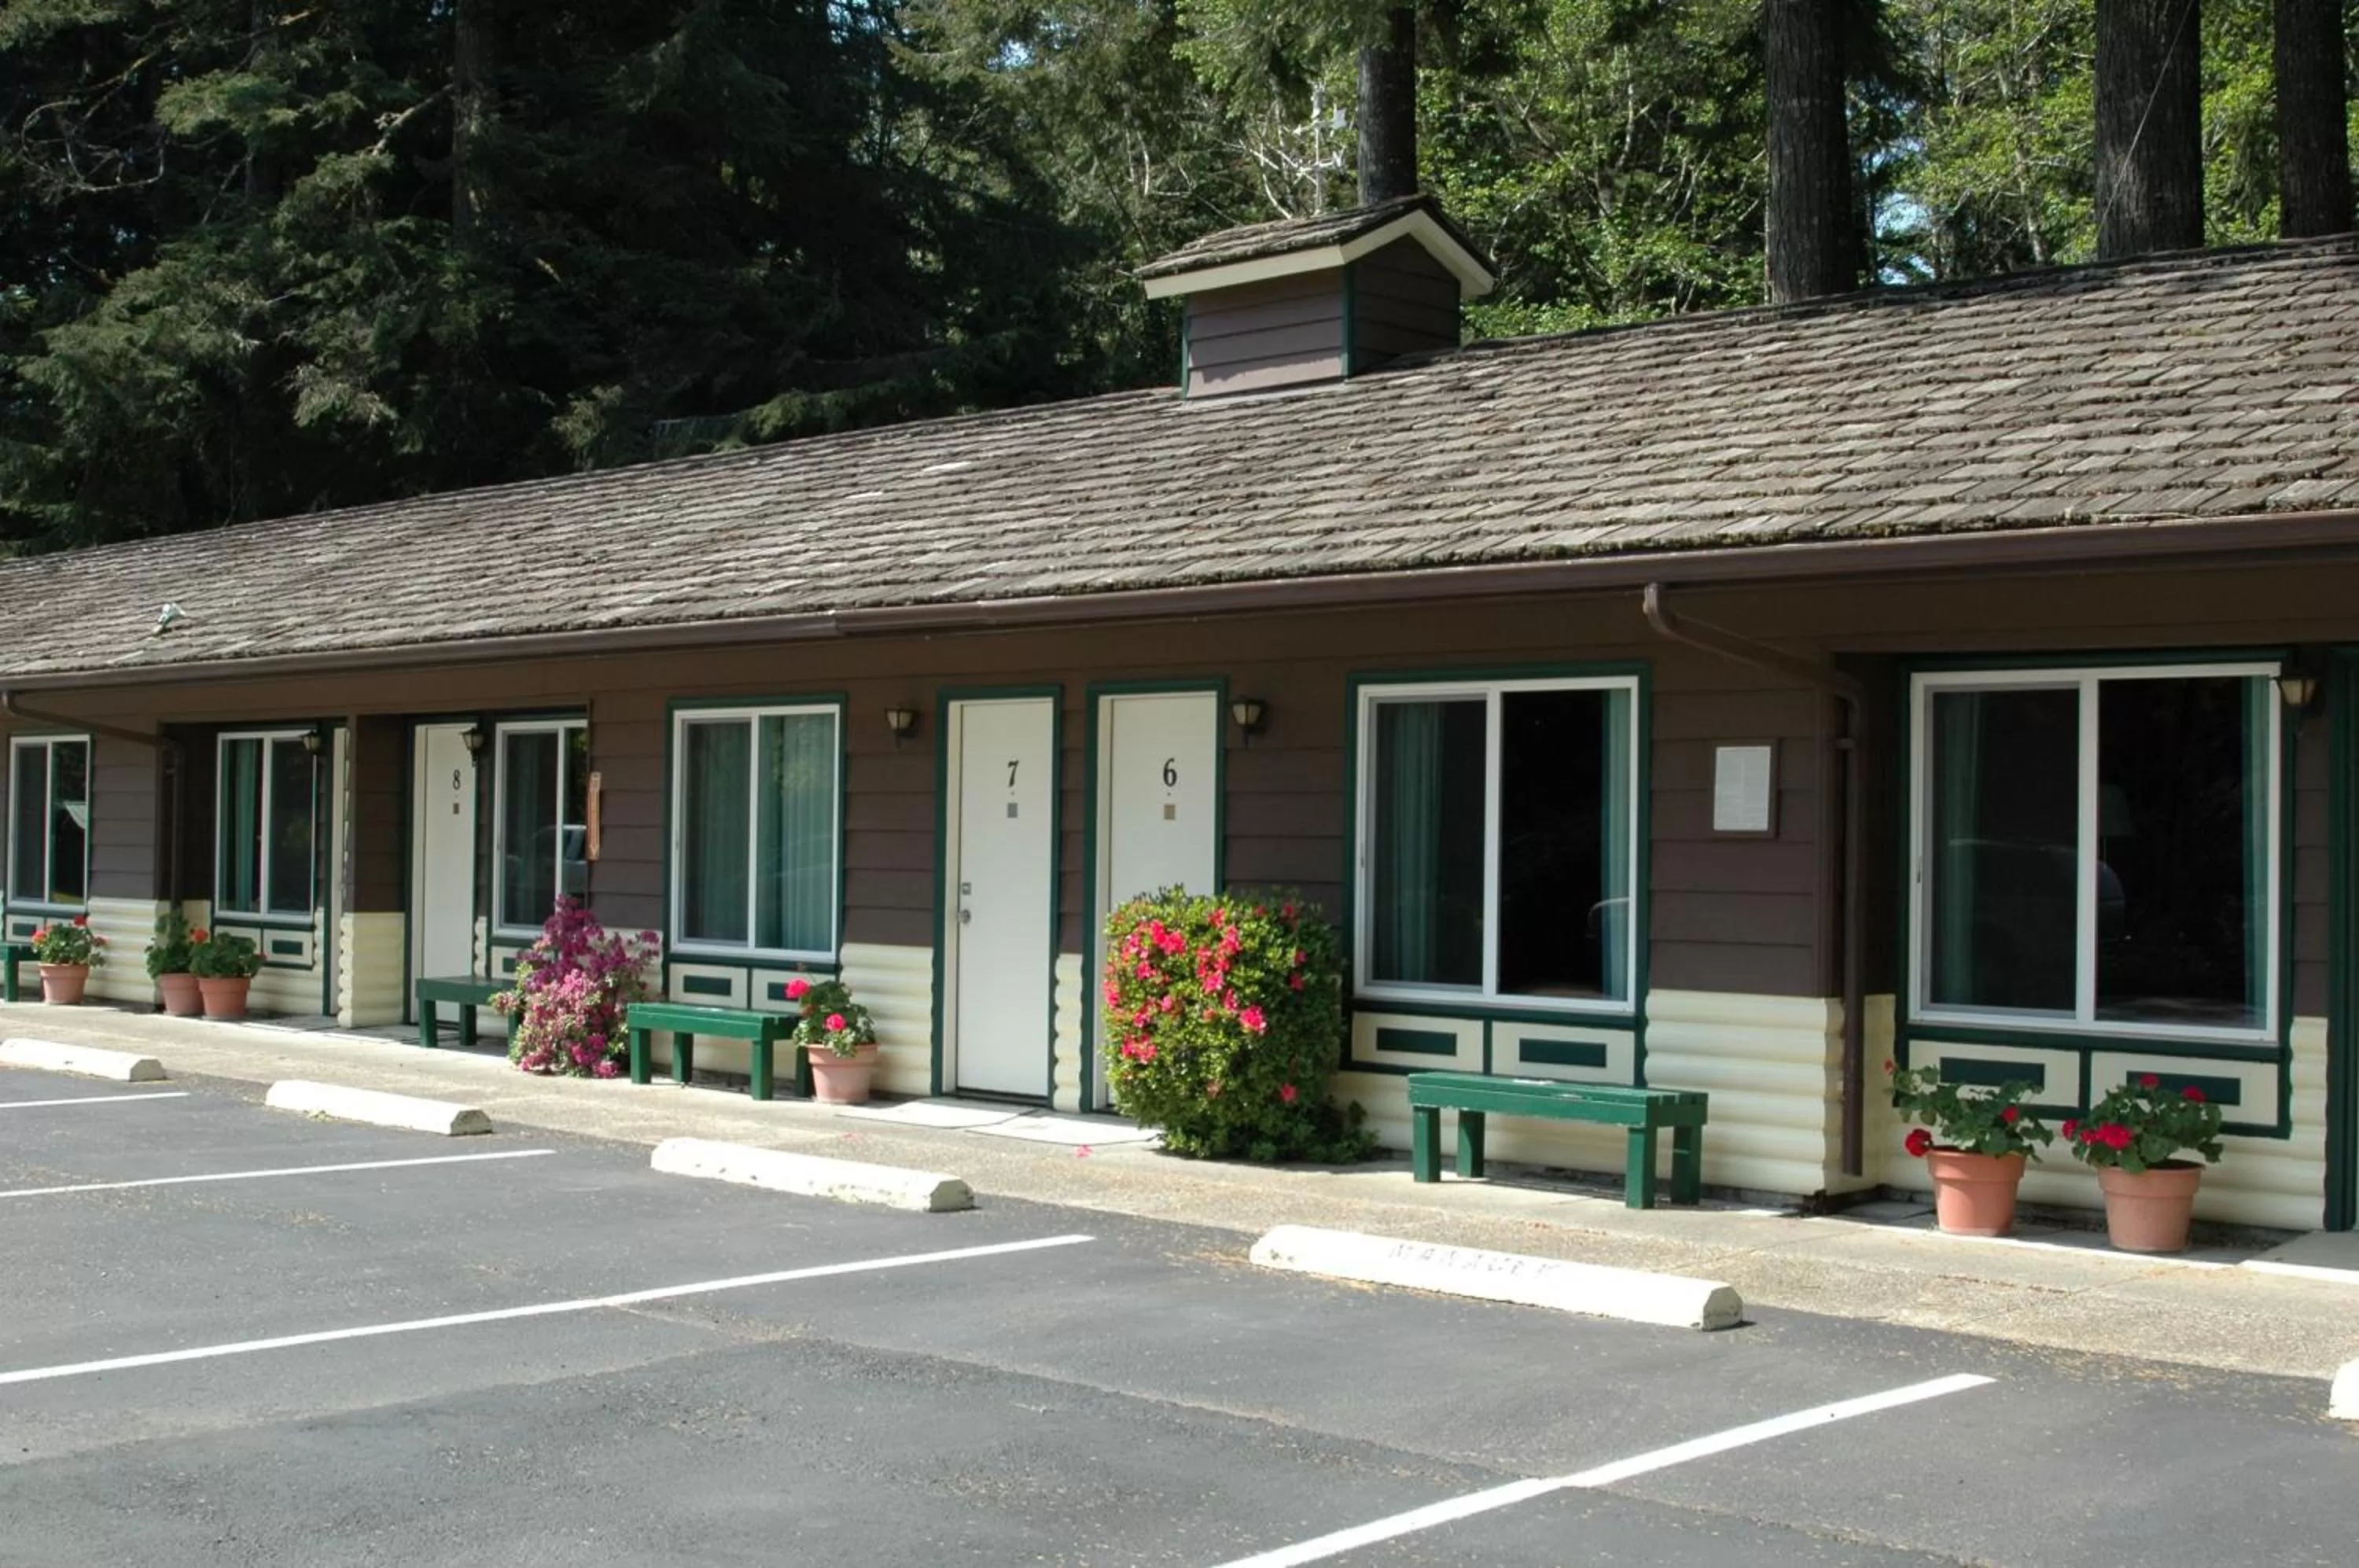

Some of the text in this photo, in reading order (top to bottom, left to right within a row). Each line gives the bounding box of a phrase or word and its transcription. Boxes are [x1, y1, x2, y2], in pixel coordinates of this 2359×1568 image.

[452, 769, 461, 790] 8
[1007, 760, 1019, 787] 7
[1163, 757, 1177, 787] 6
